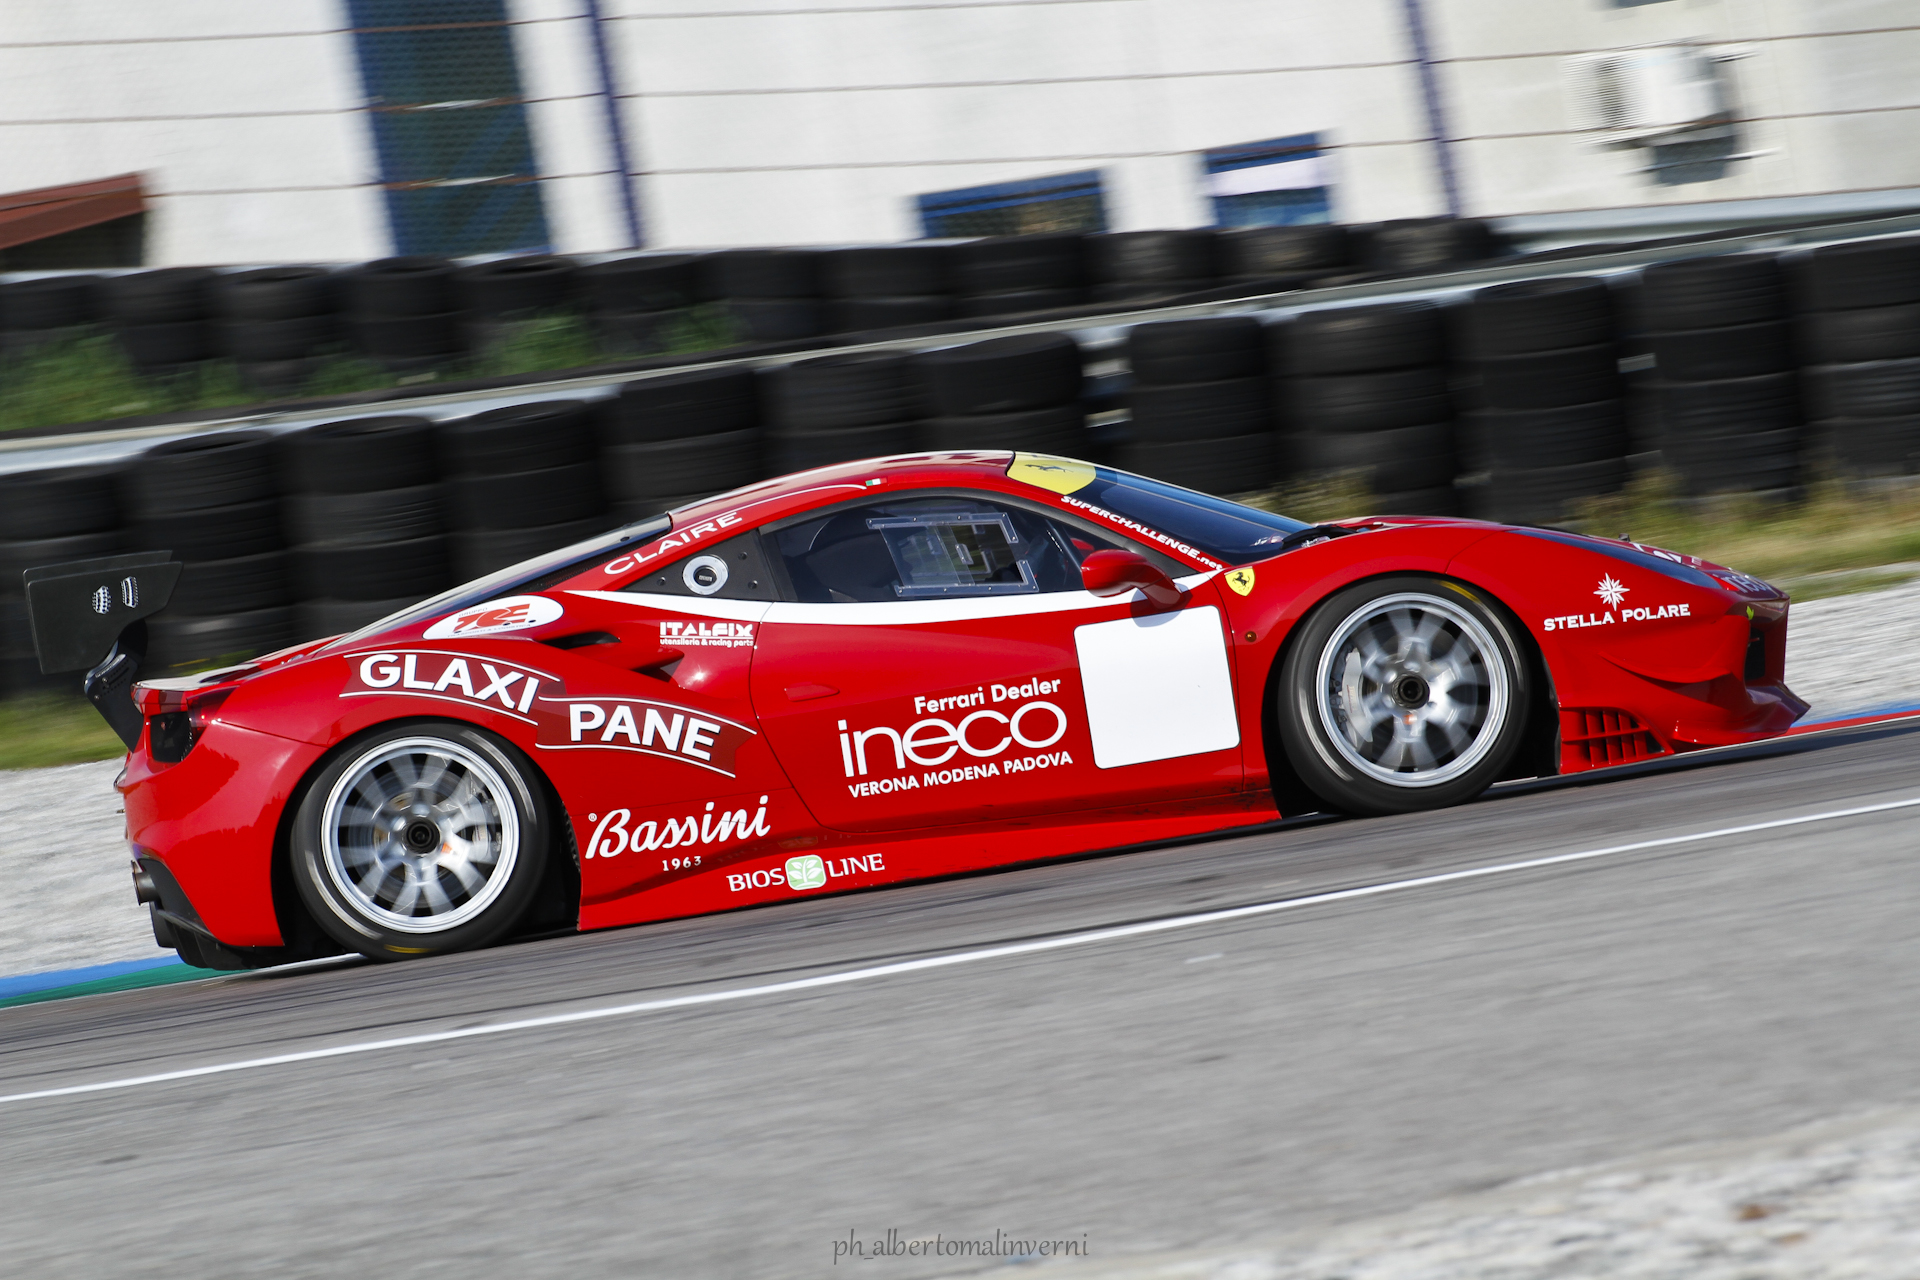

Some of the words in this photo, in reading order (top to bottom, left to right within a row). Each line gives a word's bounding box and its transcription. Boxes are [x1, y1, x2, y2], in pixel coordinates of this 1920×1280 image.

[604, 511, 743, 576] CLAIRE
[1061, 494, 1223, 572] SUPERCHALLENGE.net
[660, 621, 753, 636] ITALFIX
[1544, 611, 1615, 631] STELLA
[1622, 603, 1691, 622] POLARE
[701, 638, 708, 646] &
[709, 639, 732, 648] racing
[733, 640, 754, 648] parts
[359, 653, 540, 715] GLAXI
[914, 686, 986, 715] Ferrari
[991, 677, 1061, 703] Dealer
[569, 703, 721, 762] PANE
[837, 700, 1068, 778] ineco
[848, 774, 920, 798] VERONA
[923, 762, 1001, 788] MODENA
[1003, 750, 1073, 775] PADOVA
[585, 794, 771, 860] Bassini
[662, 855, 703, 872] 1963
[726, 867, 786, 892] BIOS
[825, 853, 886, 878] LINE
